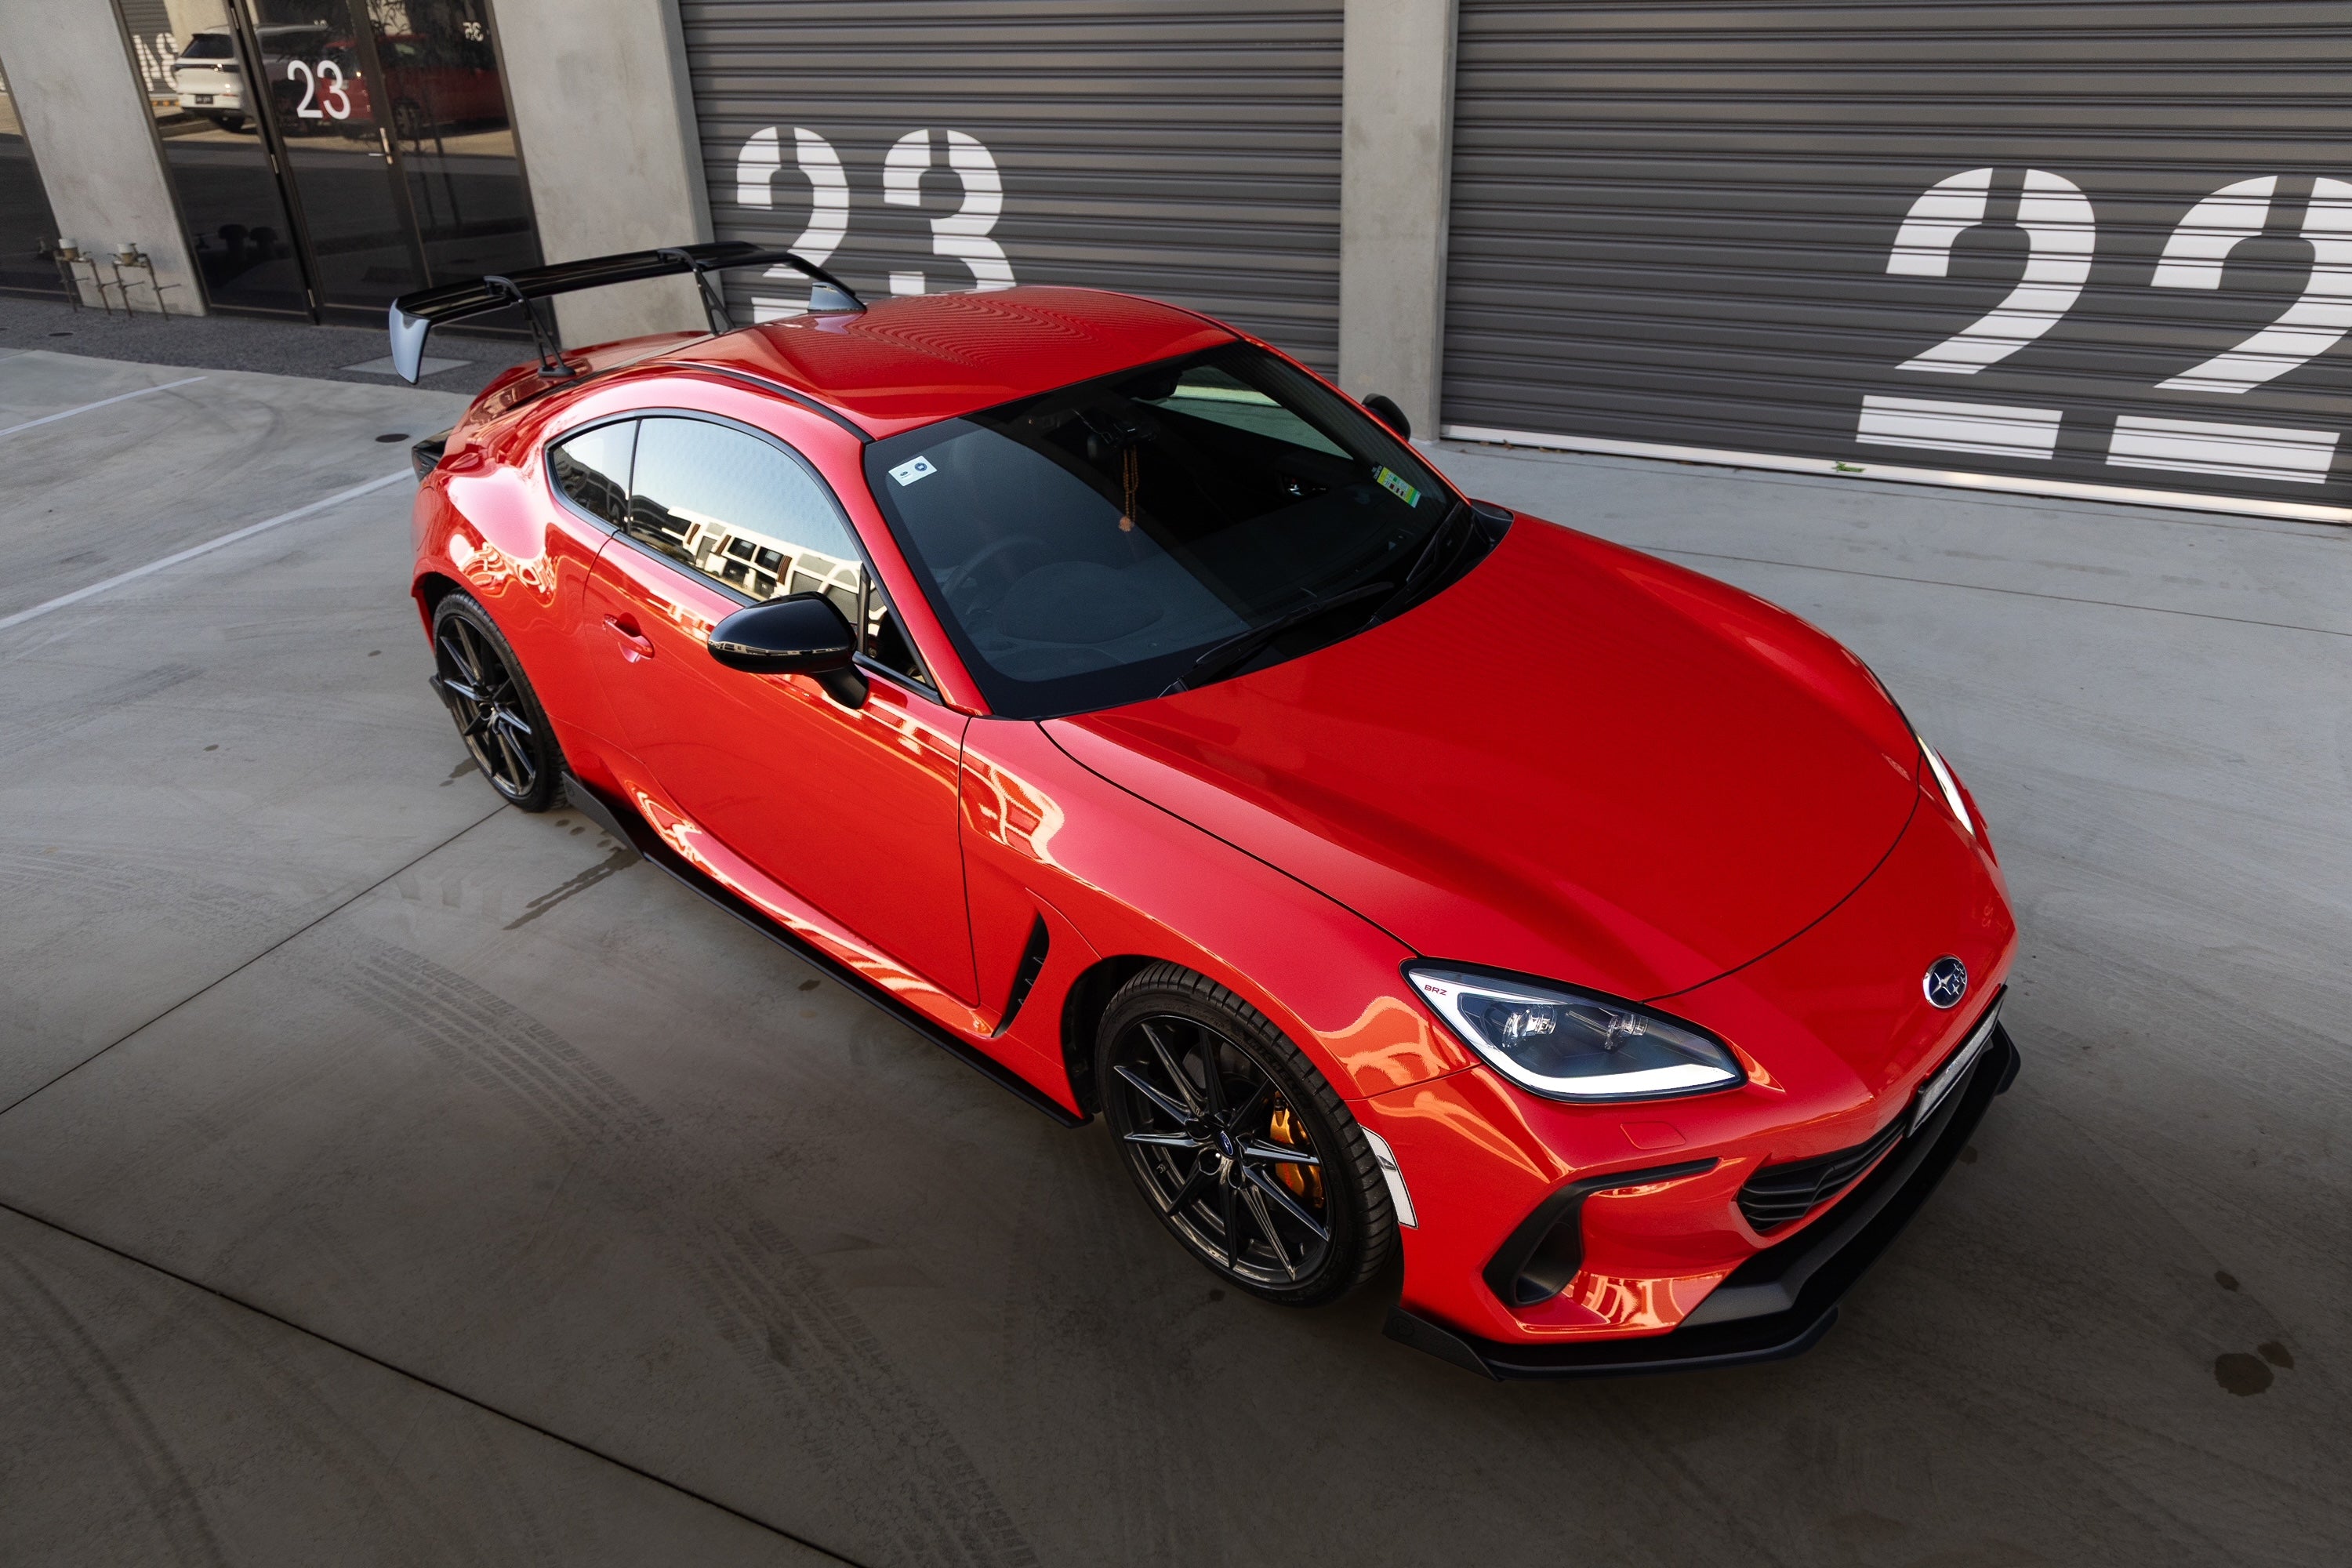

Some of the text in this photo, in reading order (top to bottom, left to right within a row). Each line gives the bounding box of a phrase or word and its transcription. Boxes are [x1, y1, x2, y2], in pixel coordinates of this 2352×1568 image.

[287, 60, 351, 120] 23
[737, 126, 1017, 323] 23
[1856, 168, 2352, 484] 22
[1425, 984, 1447, 996] BRZ
